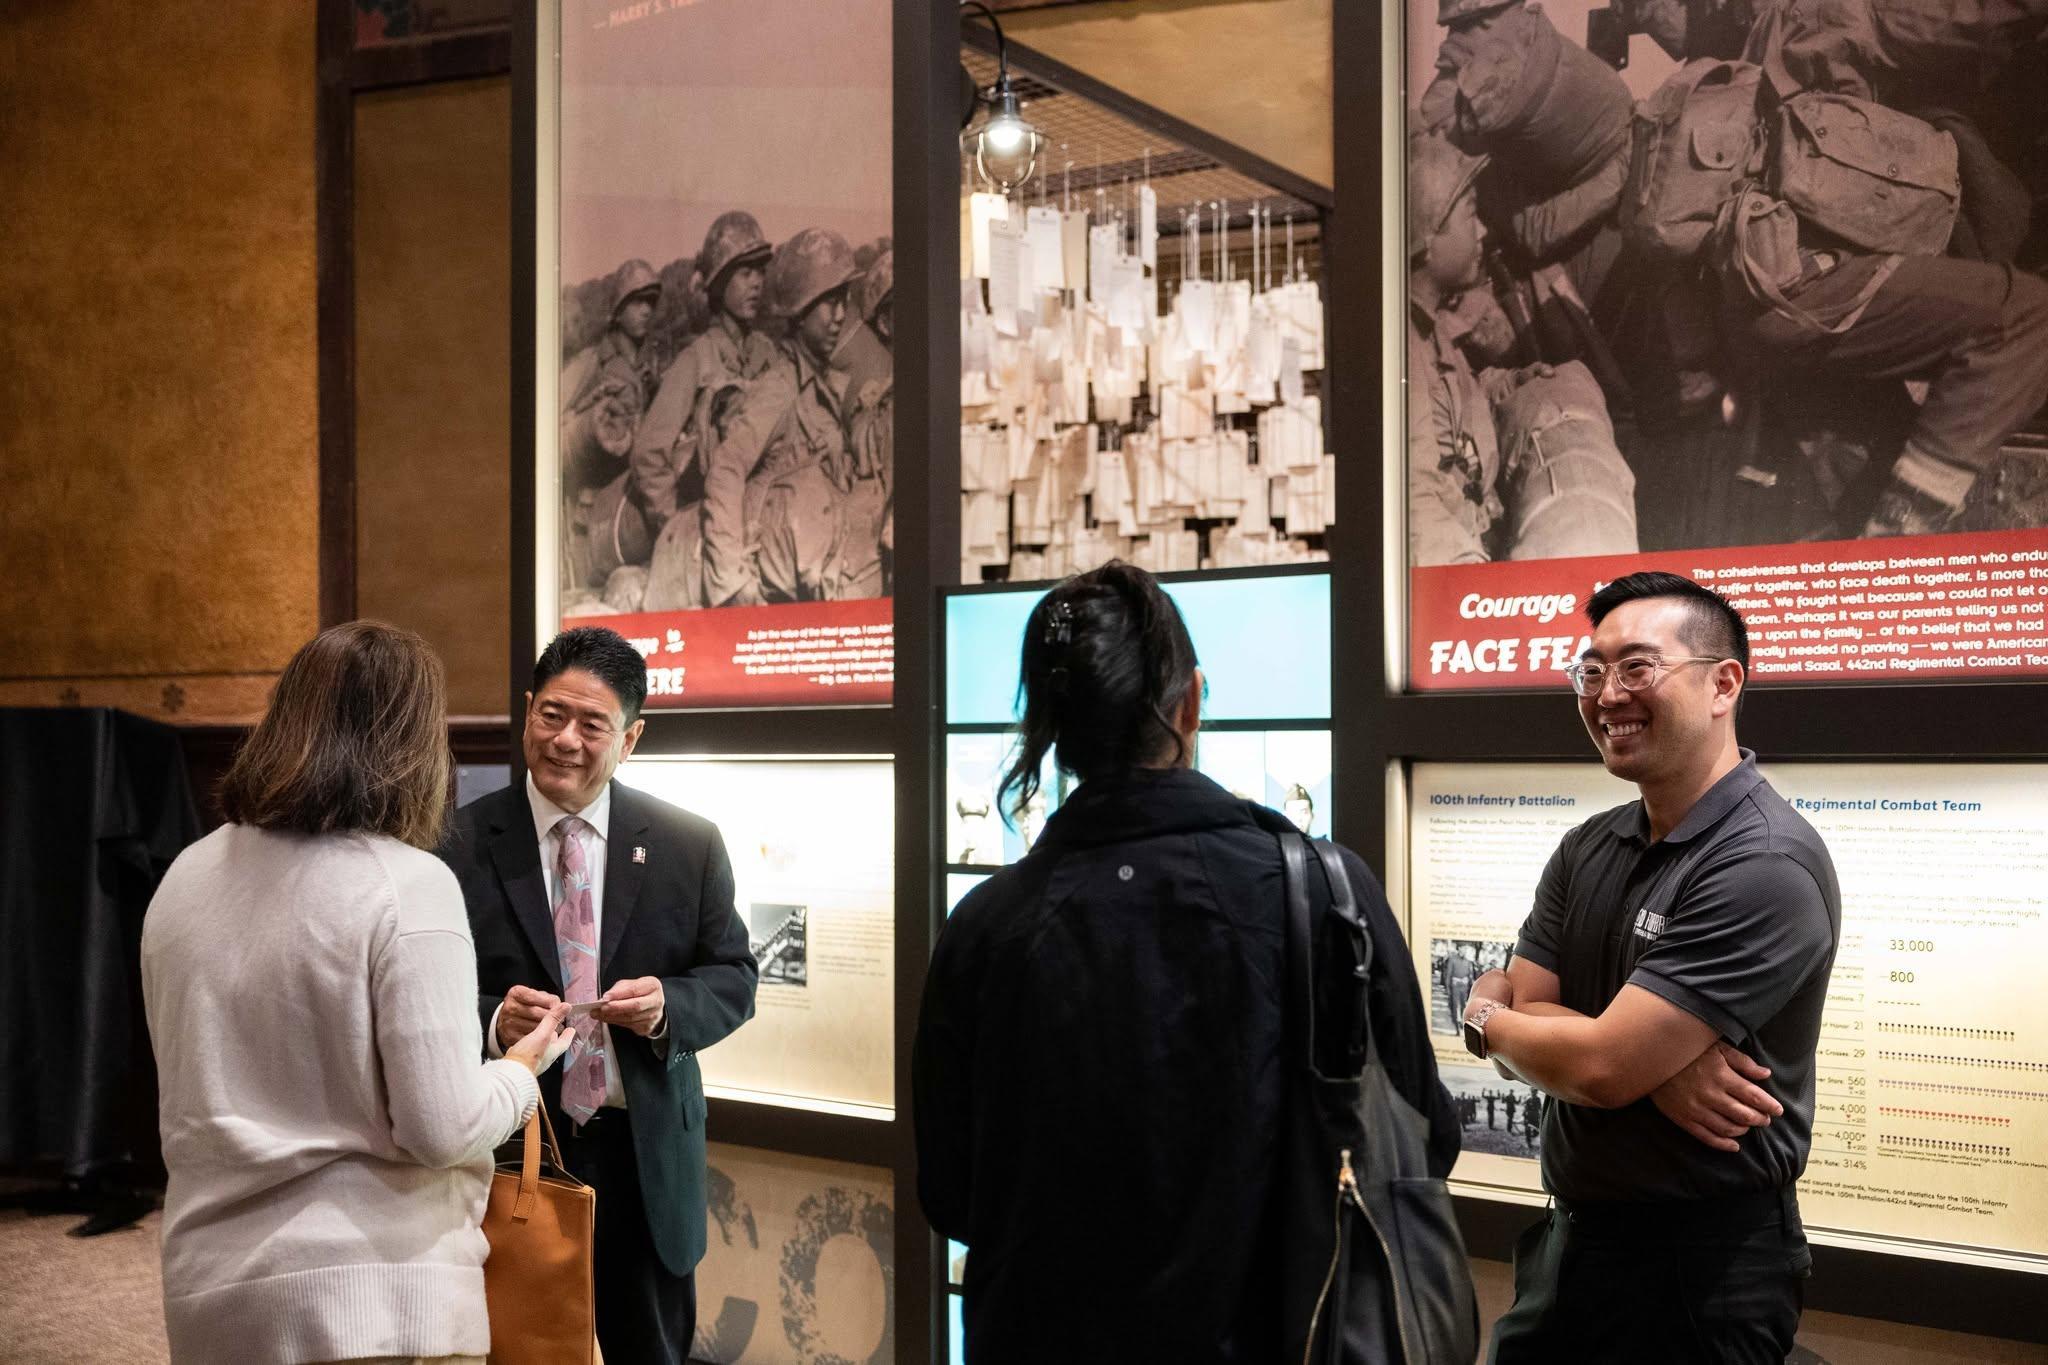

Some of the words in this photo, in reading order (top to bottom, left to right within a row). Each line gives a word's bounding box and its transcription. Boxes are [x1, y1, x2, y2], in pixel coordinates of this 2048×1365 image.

[1693, 568, 1715, 579] The
[1717, 565, 1798, 578] cohesiveness
[1800, 562, 1825, 574] that
[1828, 560, 1886, 572] develops
[1889, 557, 1944, 569] between
[1948, 554, 1977, 565] men
[1980, 552, 2007, 564] who
[1717, 583, 1752, 595] suffer
[1754, 580, 1808, 594] together,
[1812, 578, 1836, 589] who
[1839, 577, 1869, 590] face
[1872, 574, 1910, 587] death
[1914, 571, 1972, 586] together,
[1977, 570, 1987, 581] is
[1991, 569, 2025, 581] more
[1774, 597, 1793, 607] We
[1797, 594, 1837, 608] fought
[1840, 593, 1864, 604] well
[1867, 590, 1924, 603] because
[1927, 590, 1945, 600] we
[1949, 587, 1987, 600] could
[1990, 586, 2013, 598] not
[2017, 585, 2034, 597] let
[1460, 593, 1576, 623] Courage
[1746, 614, 1780, 624] down.
[1784, 612, 1836, 624] Perhaps
[1839, 610, 1847, 621] it
[1850, 610, 1874, 621] was
[1877, 609, 1899, 620] our
[1902, 606, 1953, 620] parents
[1956, 604, 1997, 617] telling
[2002, 604, 2017, 614] us
[2021, 602, 2044, 613] not
[1766, 629, 1797, 641] upon
[1800, 628, 1821, 639] the
[1824, 626, 1862, 640] family
[1880, 626, 1894, 636] or
[1897, 624, 1918, 635] the
[1922, 622, 1961, 635] belief
[1963, 621, 1990, 633] that
[1994, 622, 2012, 632] we
[2016, 619, 2044, 631] had
[1430, 638, 1520, 674] FACE
[1752, 646, 1786, 658] really
[1789, 644, 1838, 656] needed
[1841, 644, 1858, 653] no
[1861, 642, 1908, 655] proving
[1930, 641, 1948, 650] we
[1952, 640, 1983, 650] were
[1756, 661, 1802, 673] Samuel
[1847, 658, 1886, 670] 442nd
[1890, 657, 1964, 671] Regimental
[1968, 655, 2021, 667] Combat
[1430, 794, 1464, 805] 100th
[1468, 794, 1516, 807] Infantry
[1519, 796, 1575, 806] Battalion
[1796, 799, 1876, 812] Regimental
[1881, 800, 1937, 811] Combat
[1943, 800, 1982, 811] Team
[1890, 940, 1934, 952] 33,000
[1853, 1049, 1865, 1058] 29
[1848, 1076, 1865, 1086] 560
[1843, 1159, 1867, 1170] 314%
[1947, 1204, 1972, 1213] Combat
[1982, 1199, 2008, 1208] Infantry
